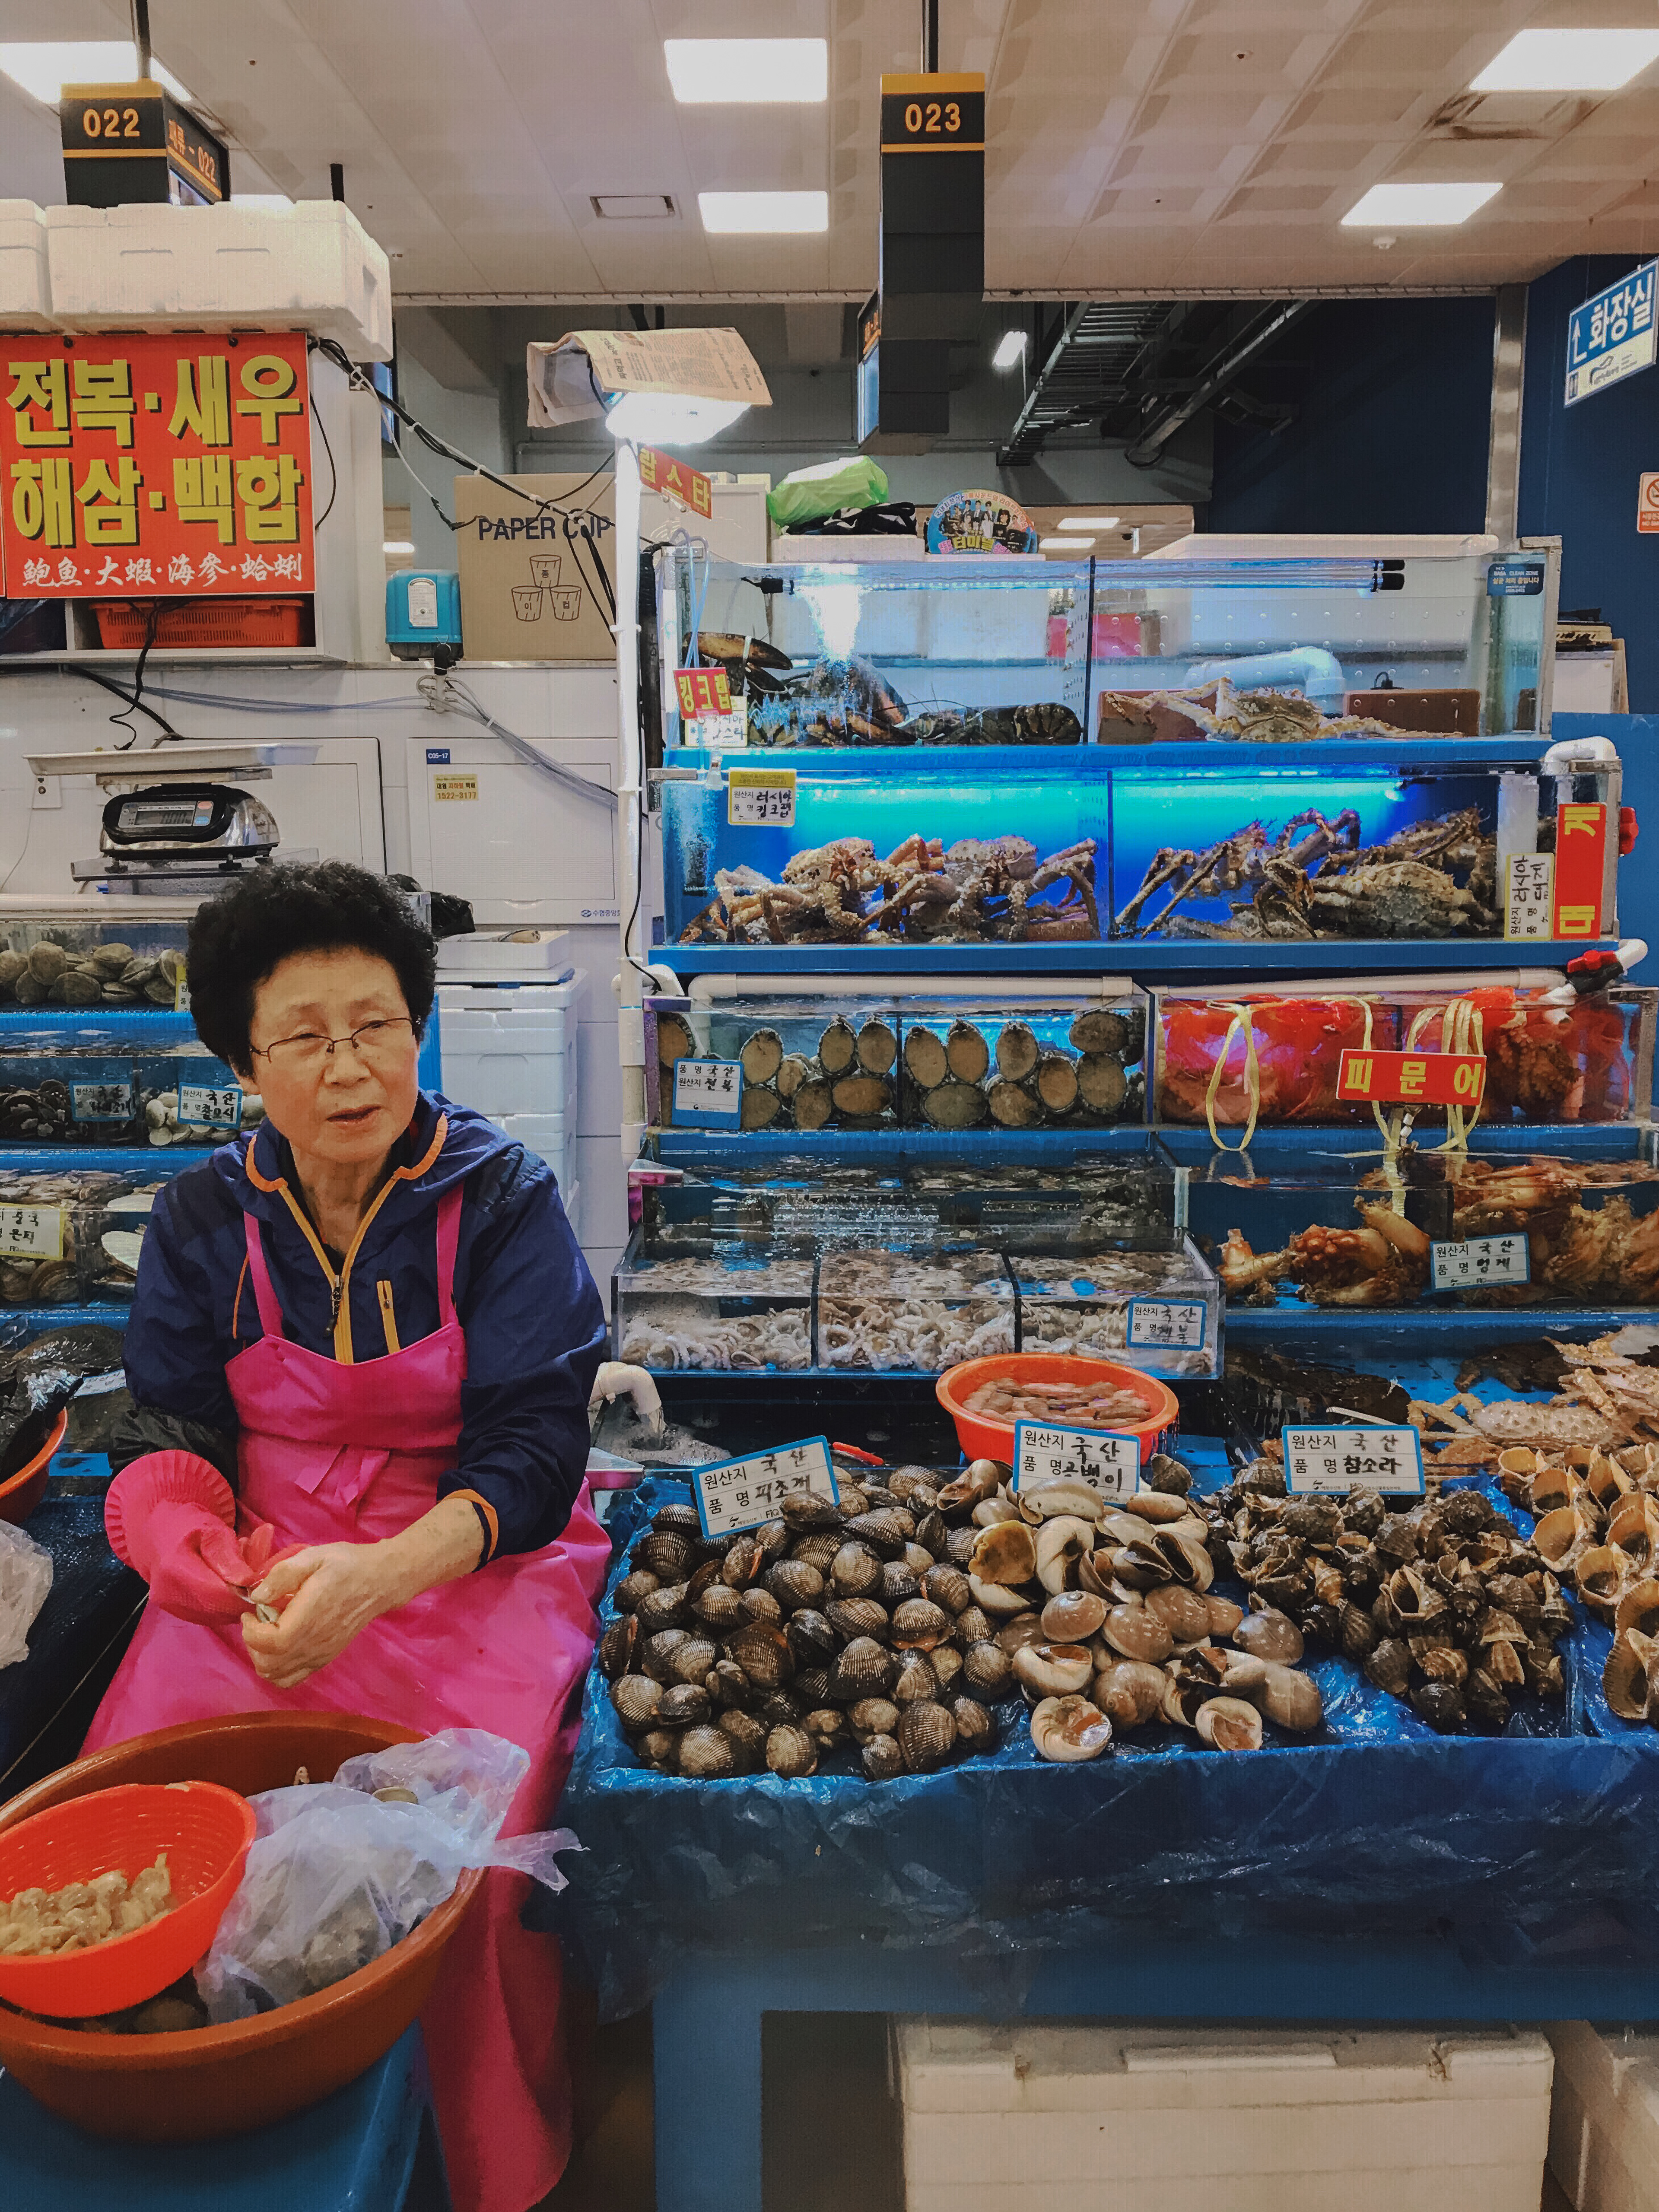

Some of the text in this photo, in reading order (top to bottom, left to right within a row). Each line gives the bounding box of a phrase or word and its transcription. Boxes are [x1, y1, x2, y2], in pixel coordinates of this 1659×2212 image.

[83, 108, 140, 137] 022
[905, 103, 960, 132] 023
[1589, 272, 1653, 349] 화장실
[479, 517, 555, 540] PAPER
[678, 1078, 701, 1087] 원산지
[183, 1090, 202, 1098] 원산지
[1437, 1240, 1515, 1258] 원산지 국산
[1135, 1306, 1157, 1316] 원산지
[1024, 1430, 1120, 1464] 원산지 국산
[1292, 1433, 1399, 1452] 원산지 국산
[704, 1446, 808, 1490] 원산지 국산
[1342, 1455, 1402, 1475] 참소라
